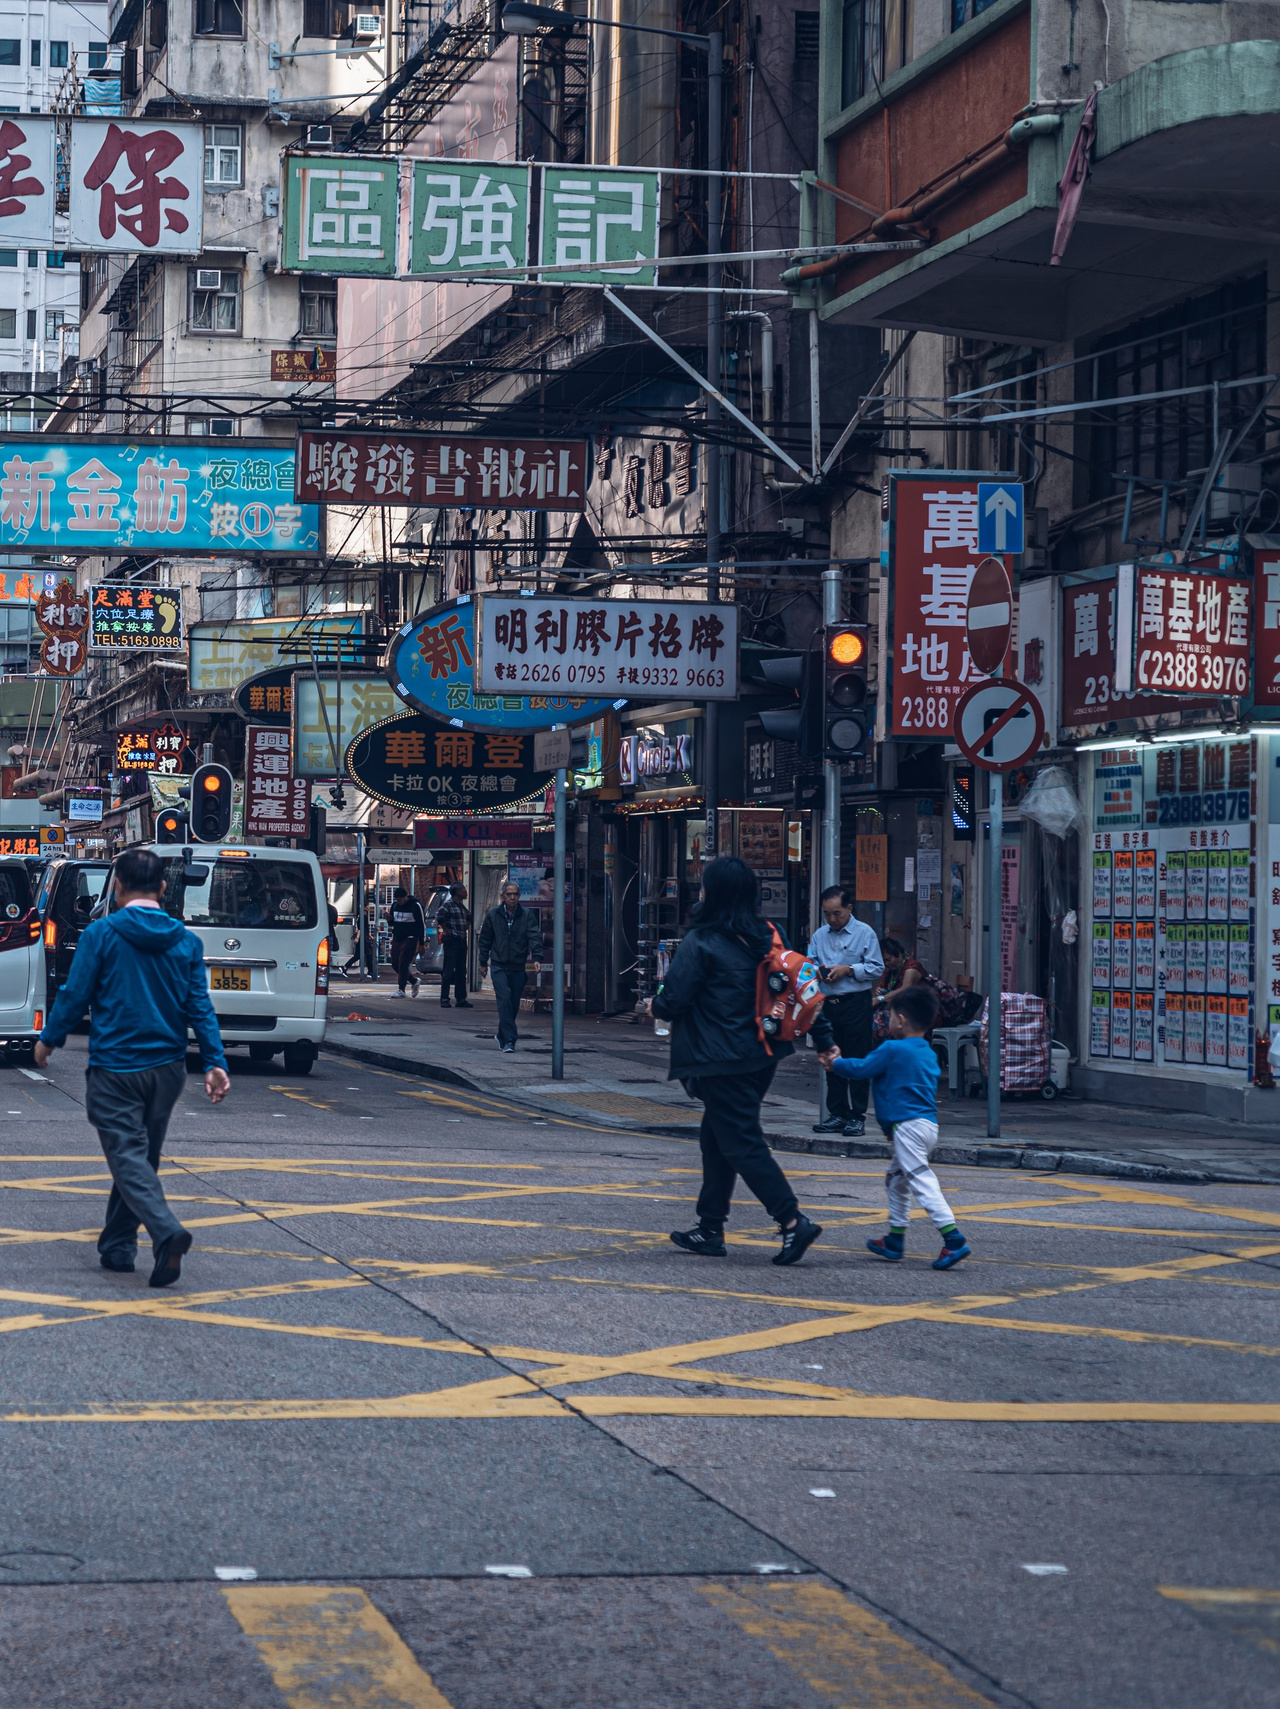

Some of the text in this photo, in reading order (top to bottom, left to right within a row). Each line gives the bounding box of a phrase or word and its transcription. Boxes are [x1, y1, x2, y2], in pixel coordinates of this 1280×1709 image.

[0, 454, 190, 533] 新金舫
[93, 589, 154, 608] 足滿堂
[1138, 573, 1249, 646] 萬基地產
[151, 636, 179, 646] 0898
[521, 664, 561, 682] 2626
[567, 665, 606, 683] 0795
[642, 668, 679, 686] 9332
[686, 669, 725, 687] 9663
[1151, 650, 1246, 692] 2388 3976
[901, 697, 949, 727] 2388
[213, 979, 248, 990] 3855
[223, 969, 239, 980] LL
